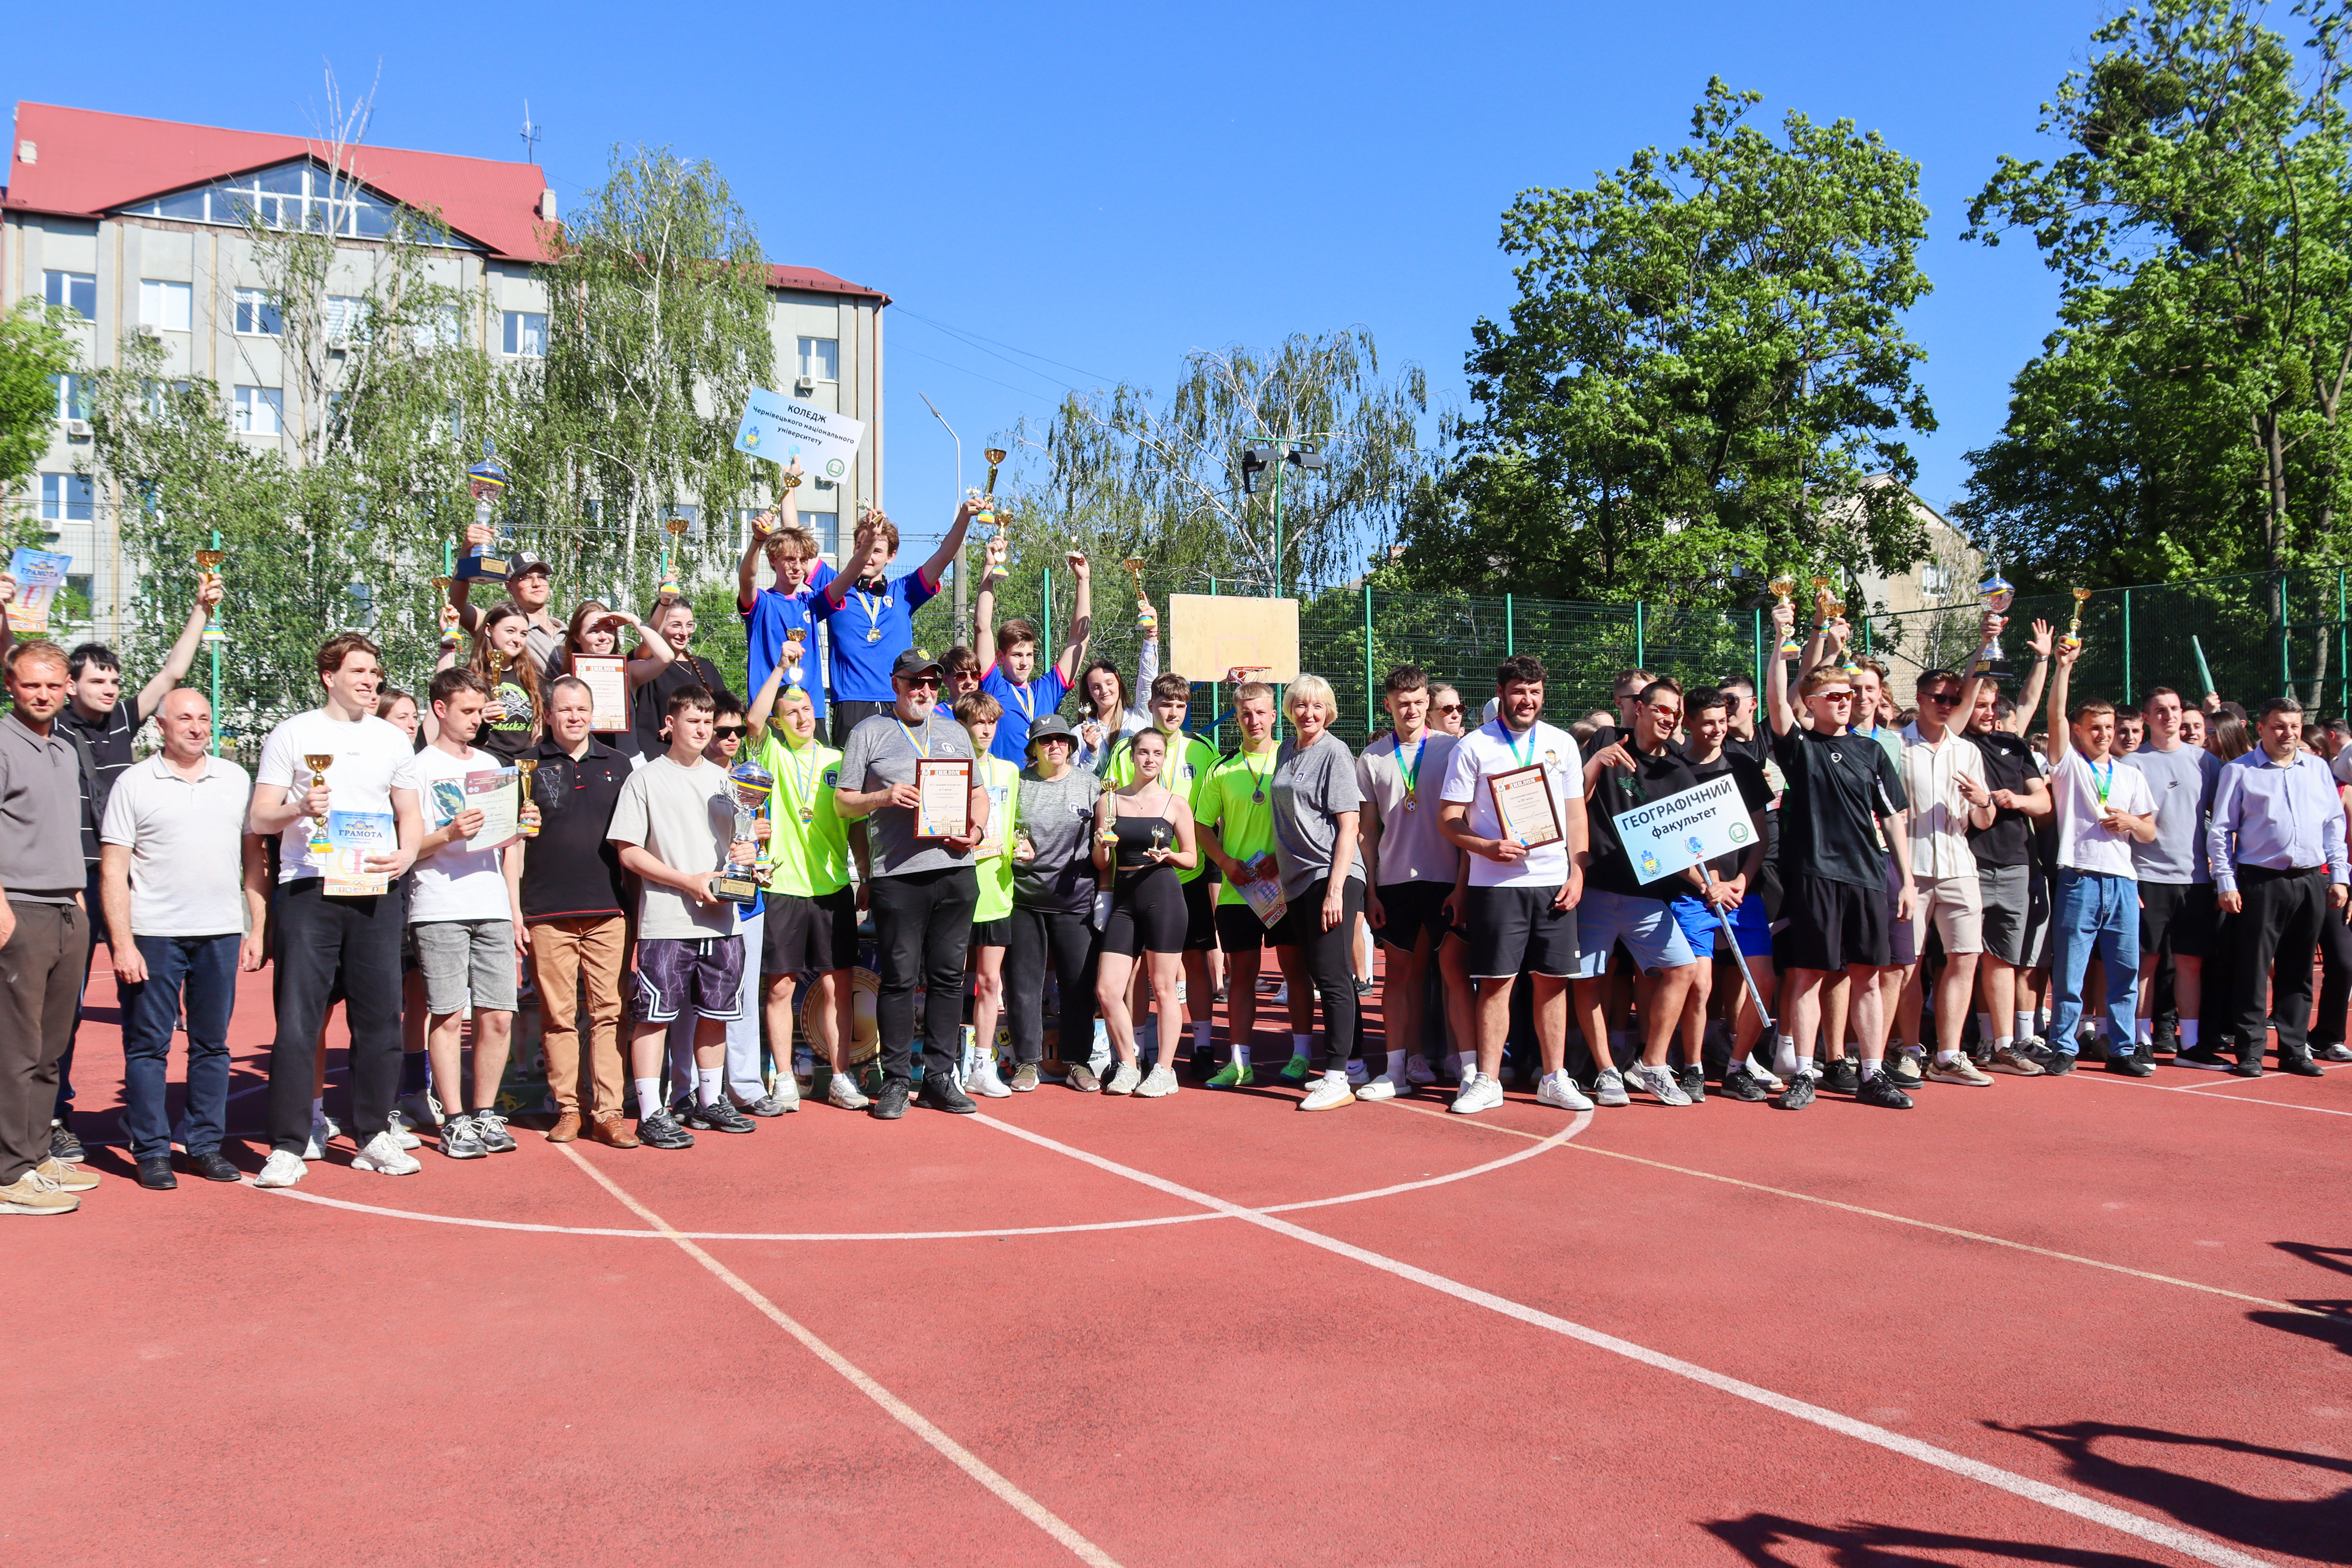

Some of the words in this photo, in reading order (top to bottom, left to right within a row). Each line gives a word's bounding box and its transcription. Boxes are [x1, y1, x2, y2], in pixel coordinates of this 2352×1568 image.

[787, 404, 827, 423] КОЛЕДЖ
[753, 406, 803, 427] Чернівецького
[804, 422, 854, 444] національного
[777, 426, 822, 446] університету
[21, 567, 58, 577] ГРАМОТА
[1509, 778, 1536, 789] ДИПЛОМ
[1622, 779, 1732, 831] ГЕОГРАФІЧНИЙ
[1652, 807, 1717, 839] факультет
[339, 830, 382, 838] ГРАМОТА
